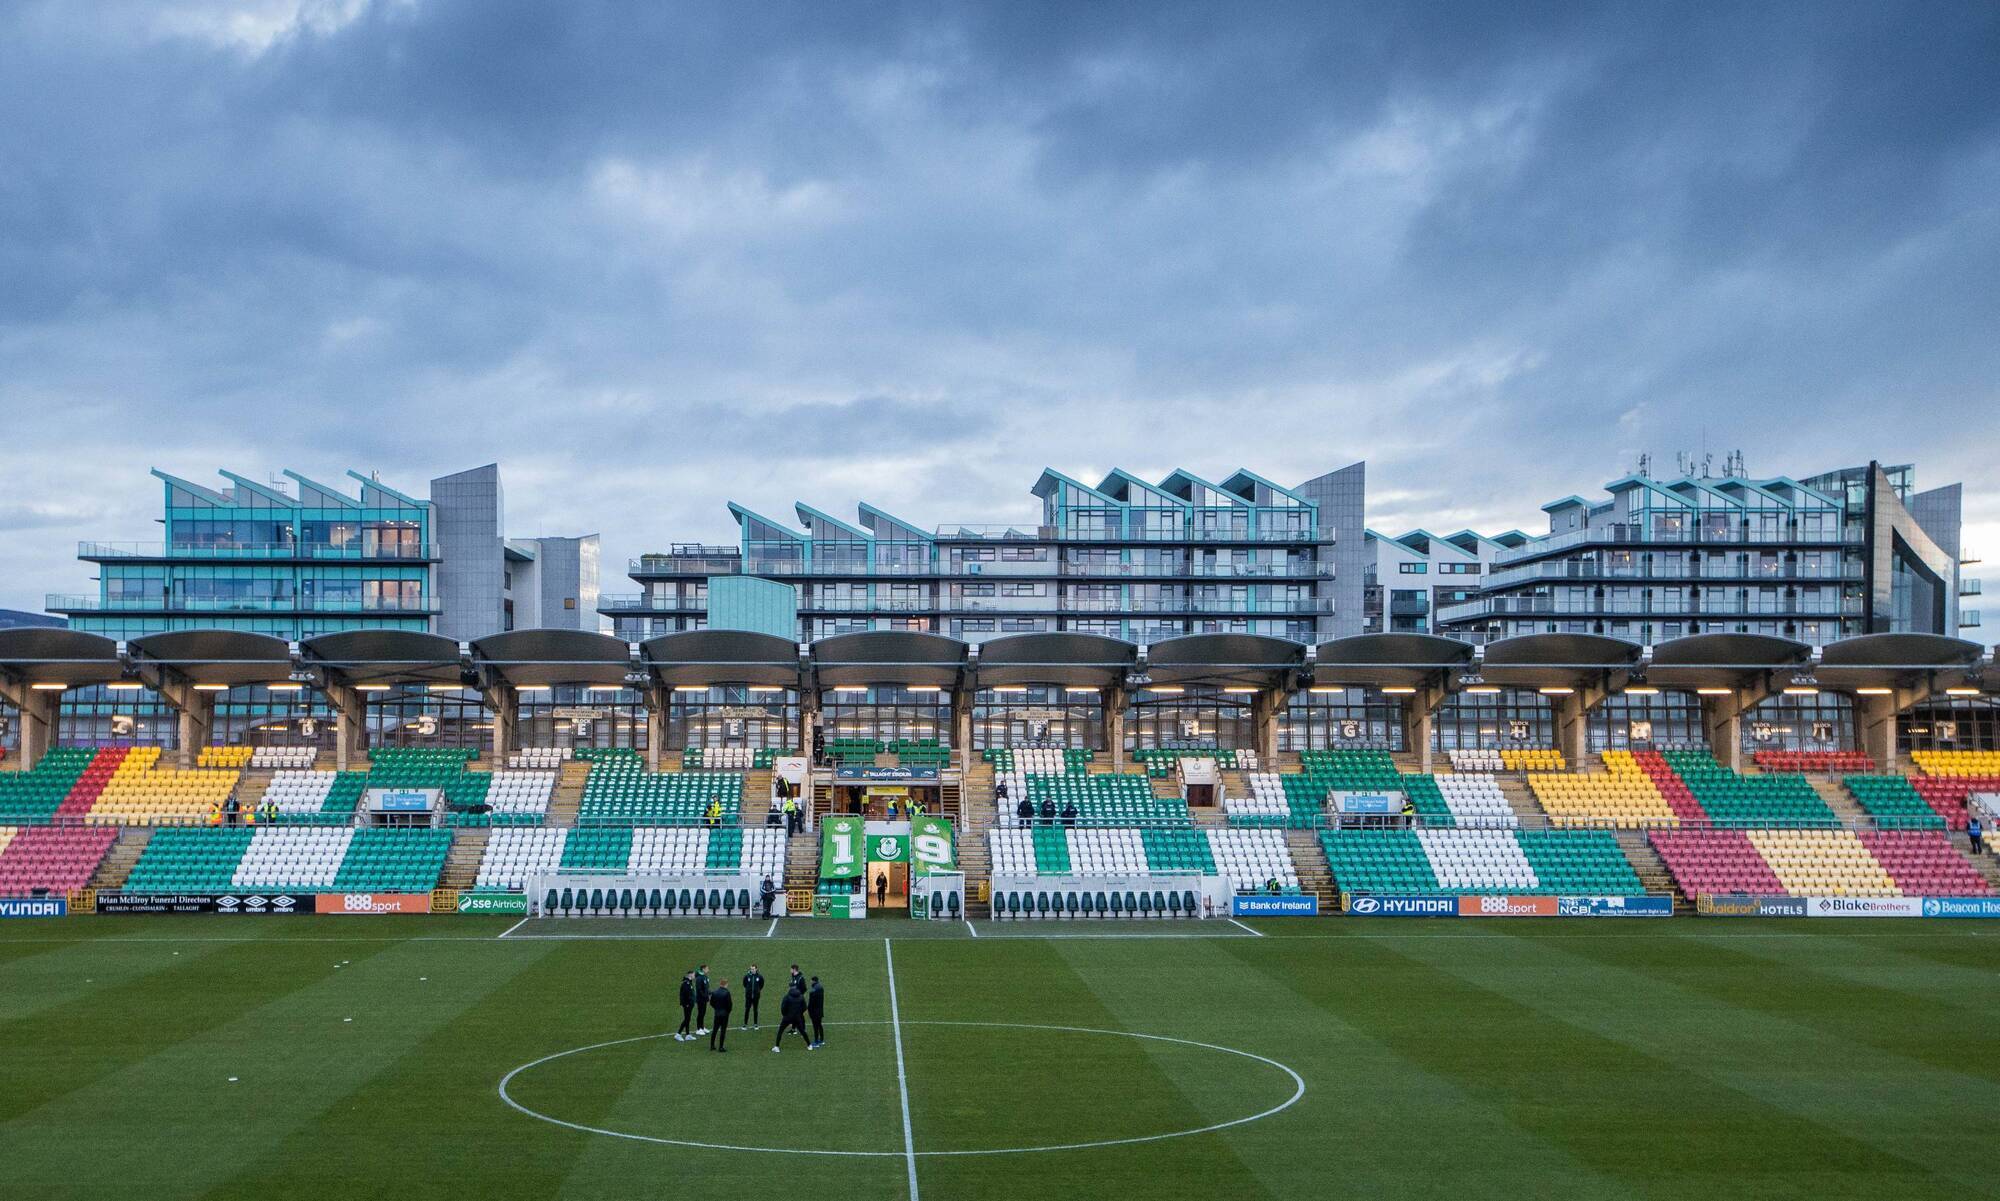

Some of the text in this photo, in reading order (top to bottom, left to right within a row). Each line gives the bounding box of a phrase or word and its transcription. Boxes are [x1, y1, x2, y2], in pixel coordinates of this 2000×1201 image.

[577, 723, 587, 736] E
[729, 723, 739, 736] E
[1343, 725, 1356, 738] G
[832, 834, 854, 865] 1
[915, 834, 952, 865] 9
[99, 896, 211, 905] Brian McElroy Funeral Directors
[472, 899, 527, 912] sse Airtricity
[1250, 902, 1311, 910] Bank of Ireland
[1384, 901, 1453, 912] HYUNDAI
[1760, 906, 1803, 915] HOTELS
[1942, 902, 1980, 913] Beacon
